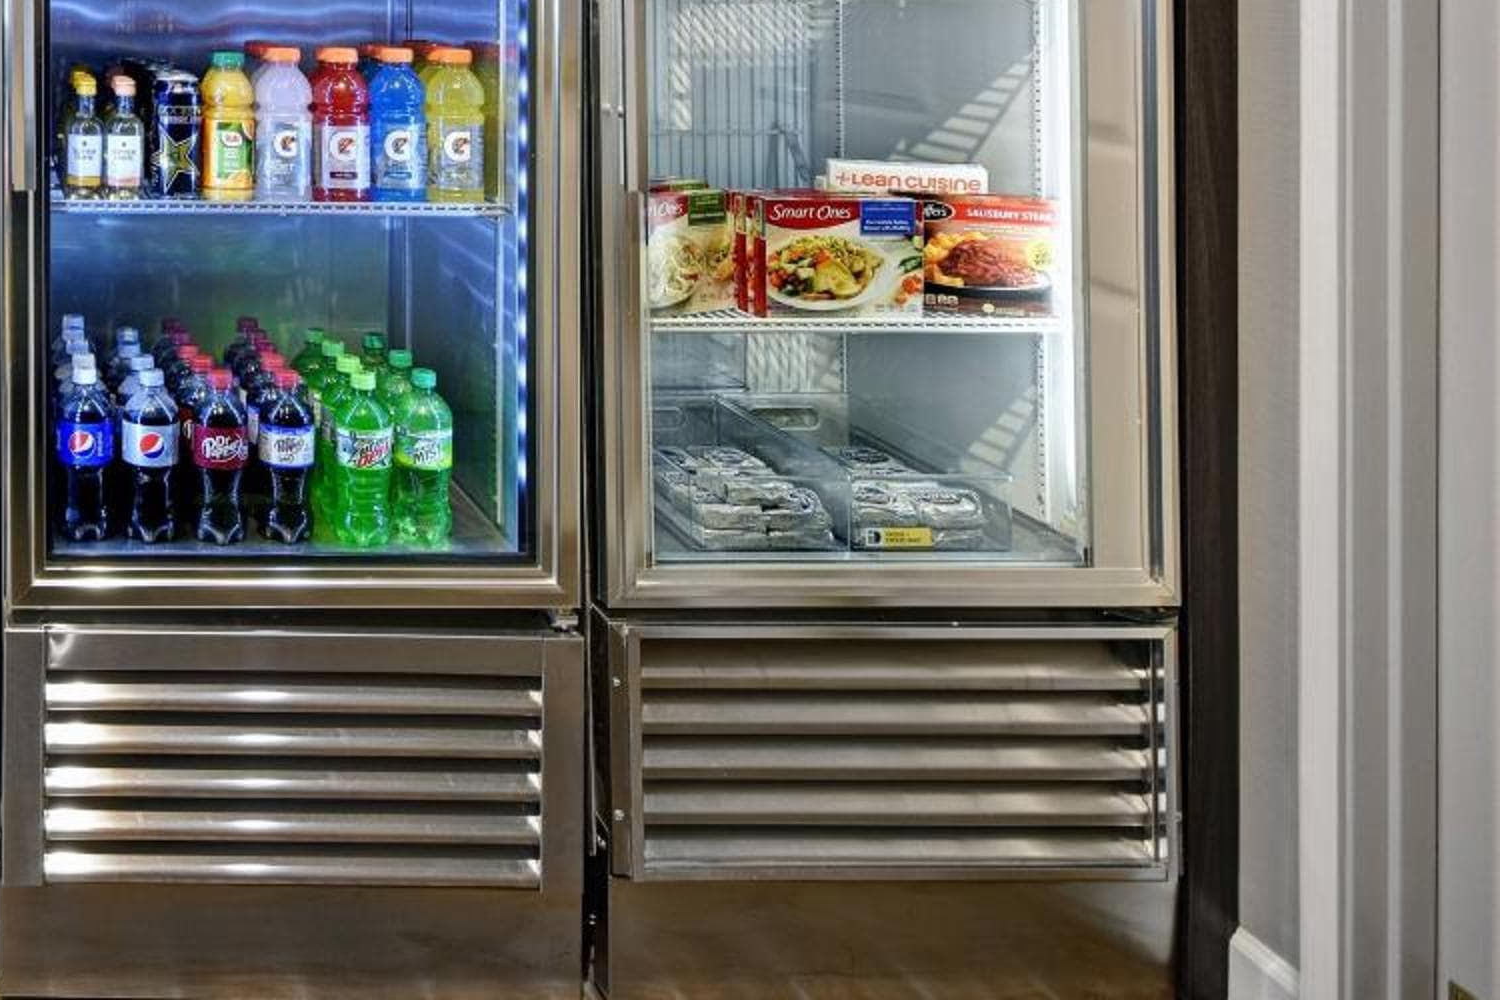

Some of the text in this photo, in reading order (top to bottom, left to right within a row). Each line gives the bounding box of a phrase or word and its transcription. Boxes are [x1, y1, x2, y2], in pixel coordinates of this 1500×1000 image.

[273, 130, 297, 158] G
[330, 131, 358, 161] G
[384, 130, 411, 161] G
[443, 131, 471, 162] G
[769, 203, 851, 221] Smart Ones
